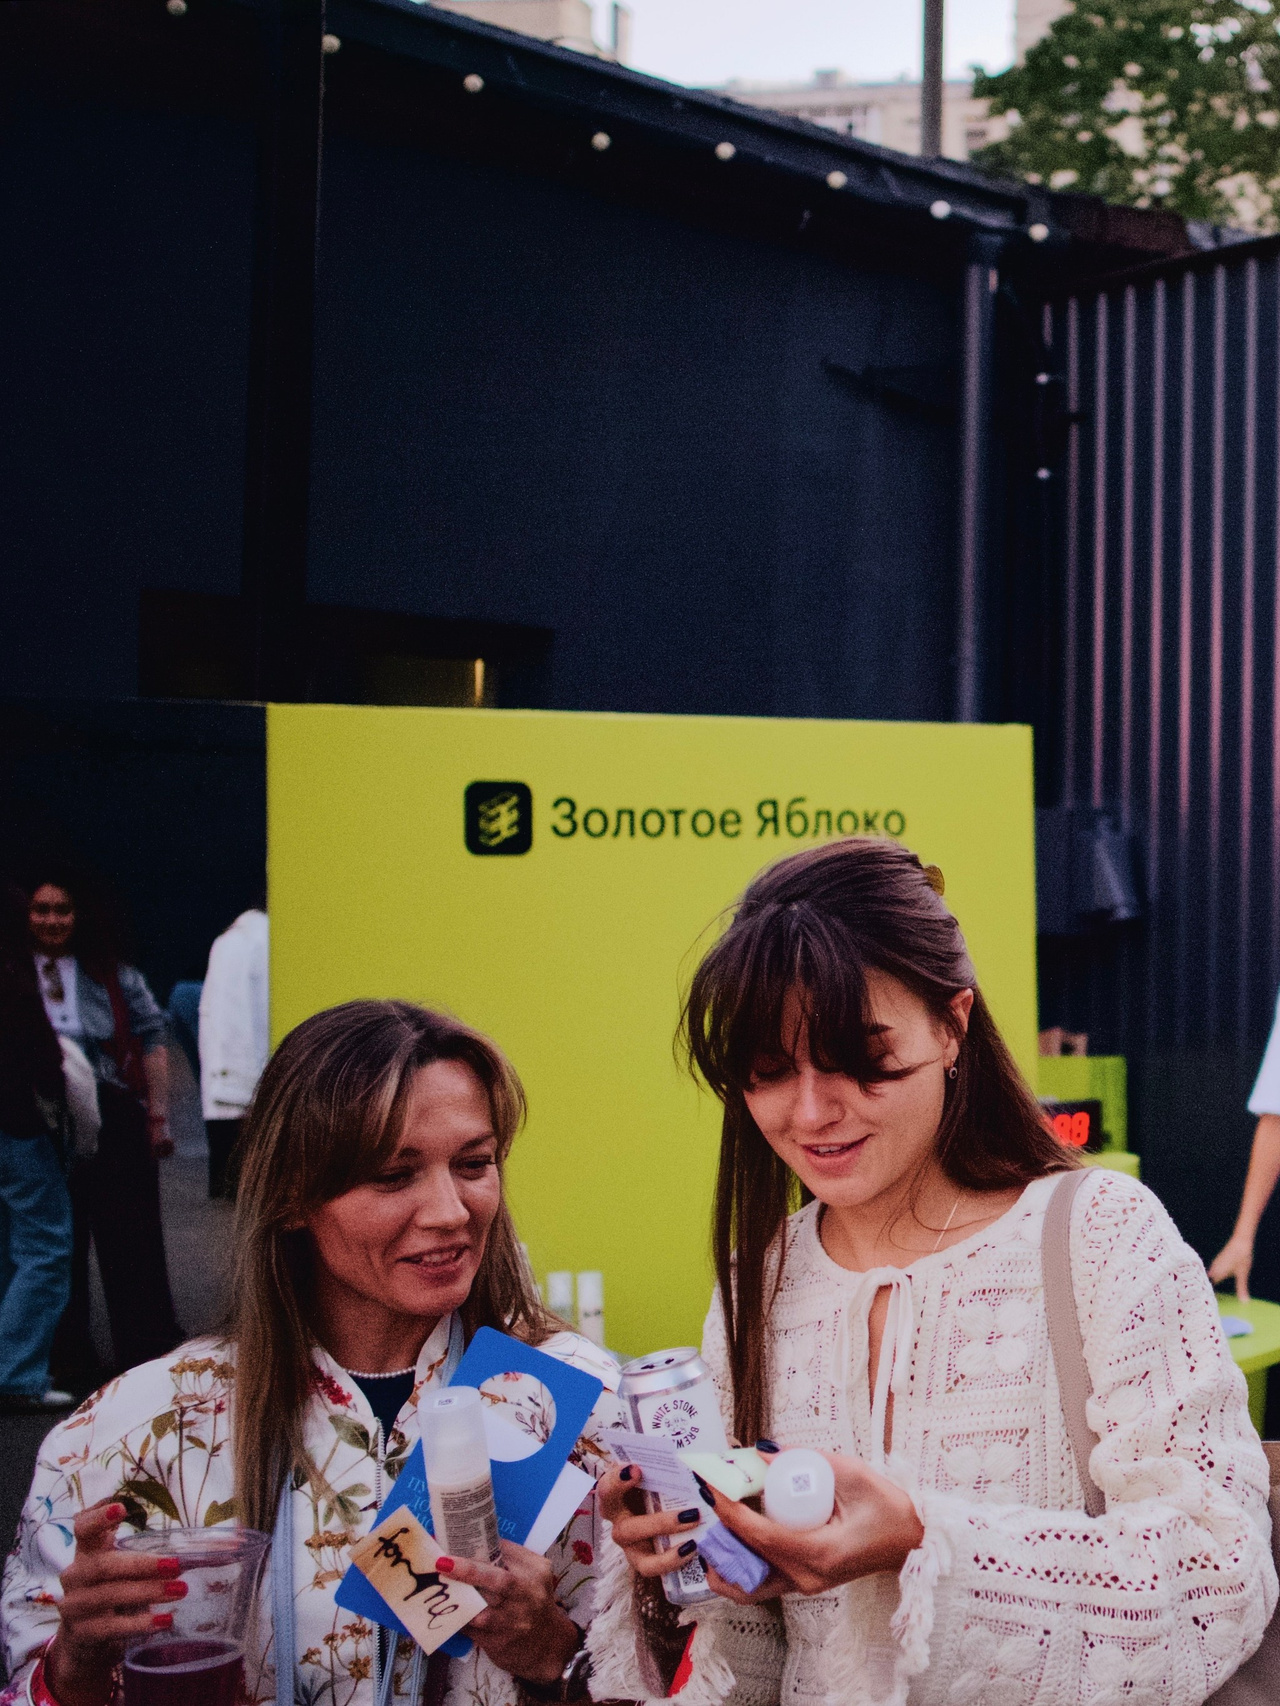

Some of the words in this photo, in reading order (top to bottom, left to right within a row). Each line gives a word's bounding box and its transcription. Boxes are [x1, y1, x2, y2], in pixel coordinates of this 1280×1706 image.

[551, 797, 742, 838] Золотое
[756, 796, 905, 838] Яблоко
[652, 1403, 671, 1430] WHITE
[673, 1399, 698, 1419] STONE
